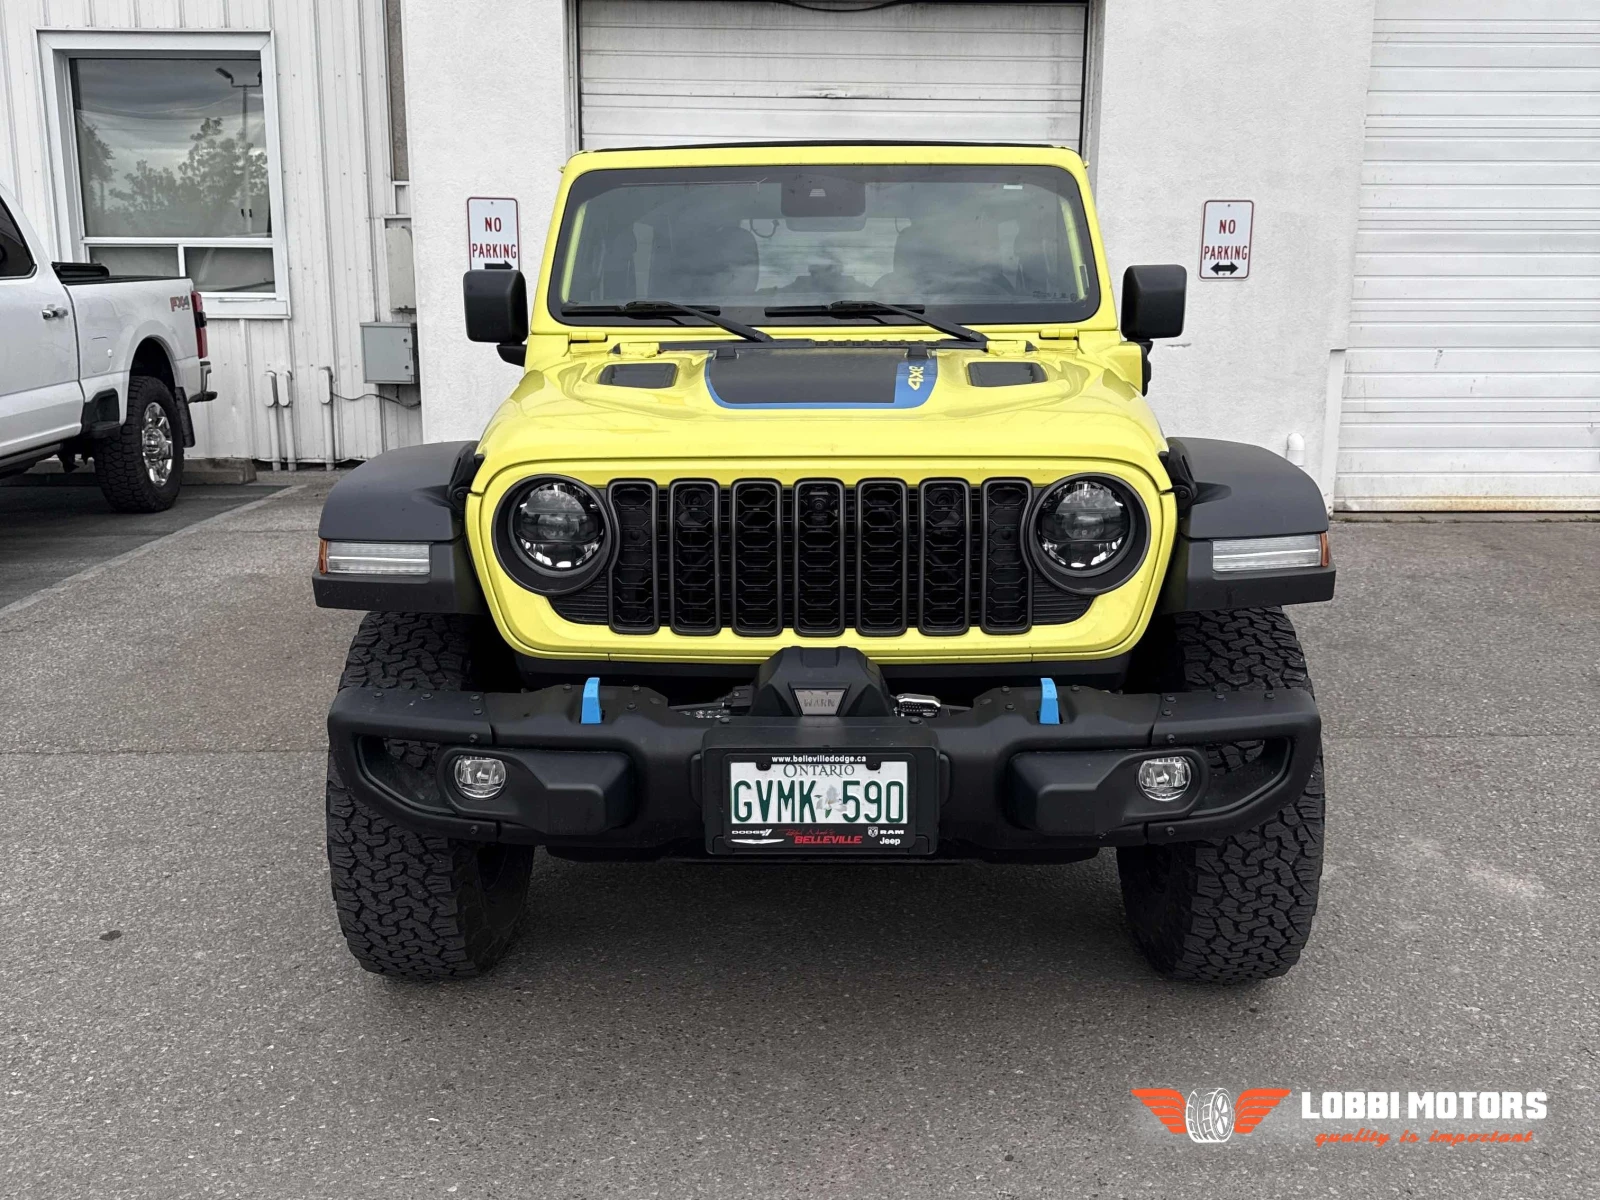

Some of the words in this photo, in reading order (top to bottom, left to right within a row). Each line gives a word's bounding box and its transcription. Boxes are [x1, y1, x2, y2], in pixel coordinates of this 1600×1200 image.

[484, 217, 502, 232] NO
[1219, 219, 1236, 234] NO
[472, 243, 517, 259] PARKING
[1203, 245, 1248, 260] PARKING
[170, 295, 190, 312] FX4
[803, 698, 836, 707] WARN
[771, 755, 867, 763] www.bellevilledodge.ca
[783, 764, 855, 778] ONTARIO
[733, 780, 817, 823] GVMK
[842, 780, 904, 823] 590
[794, 835, 863, 844] BELLEVILLE
[879, 836, 901, 846] Jeep
